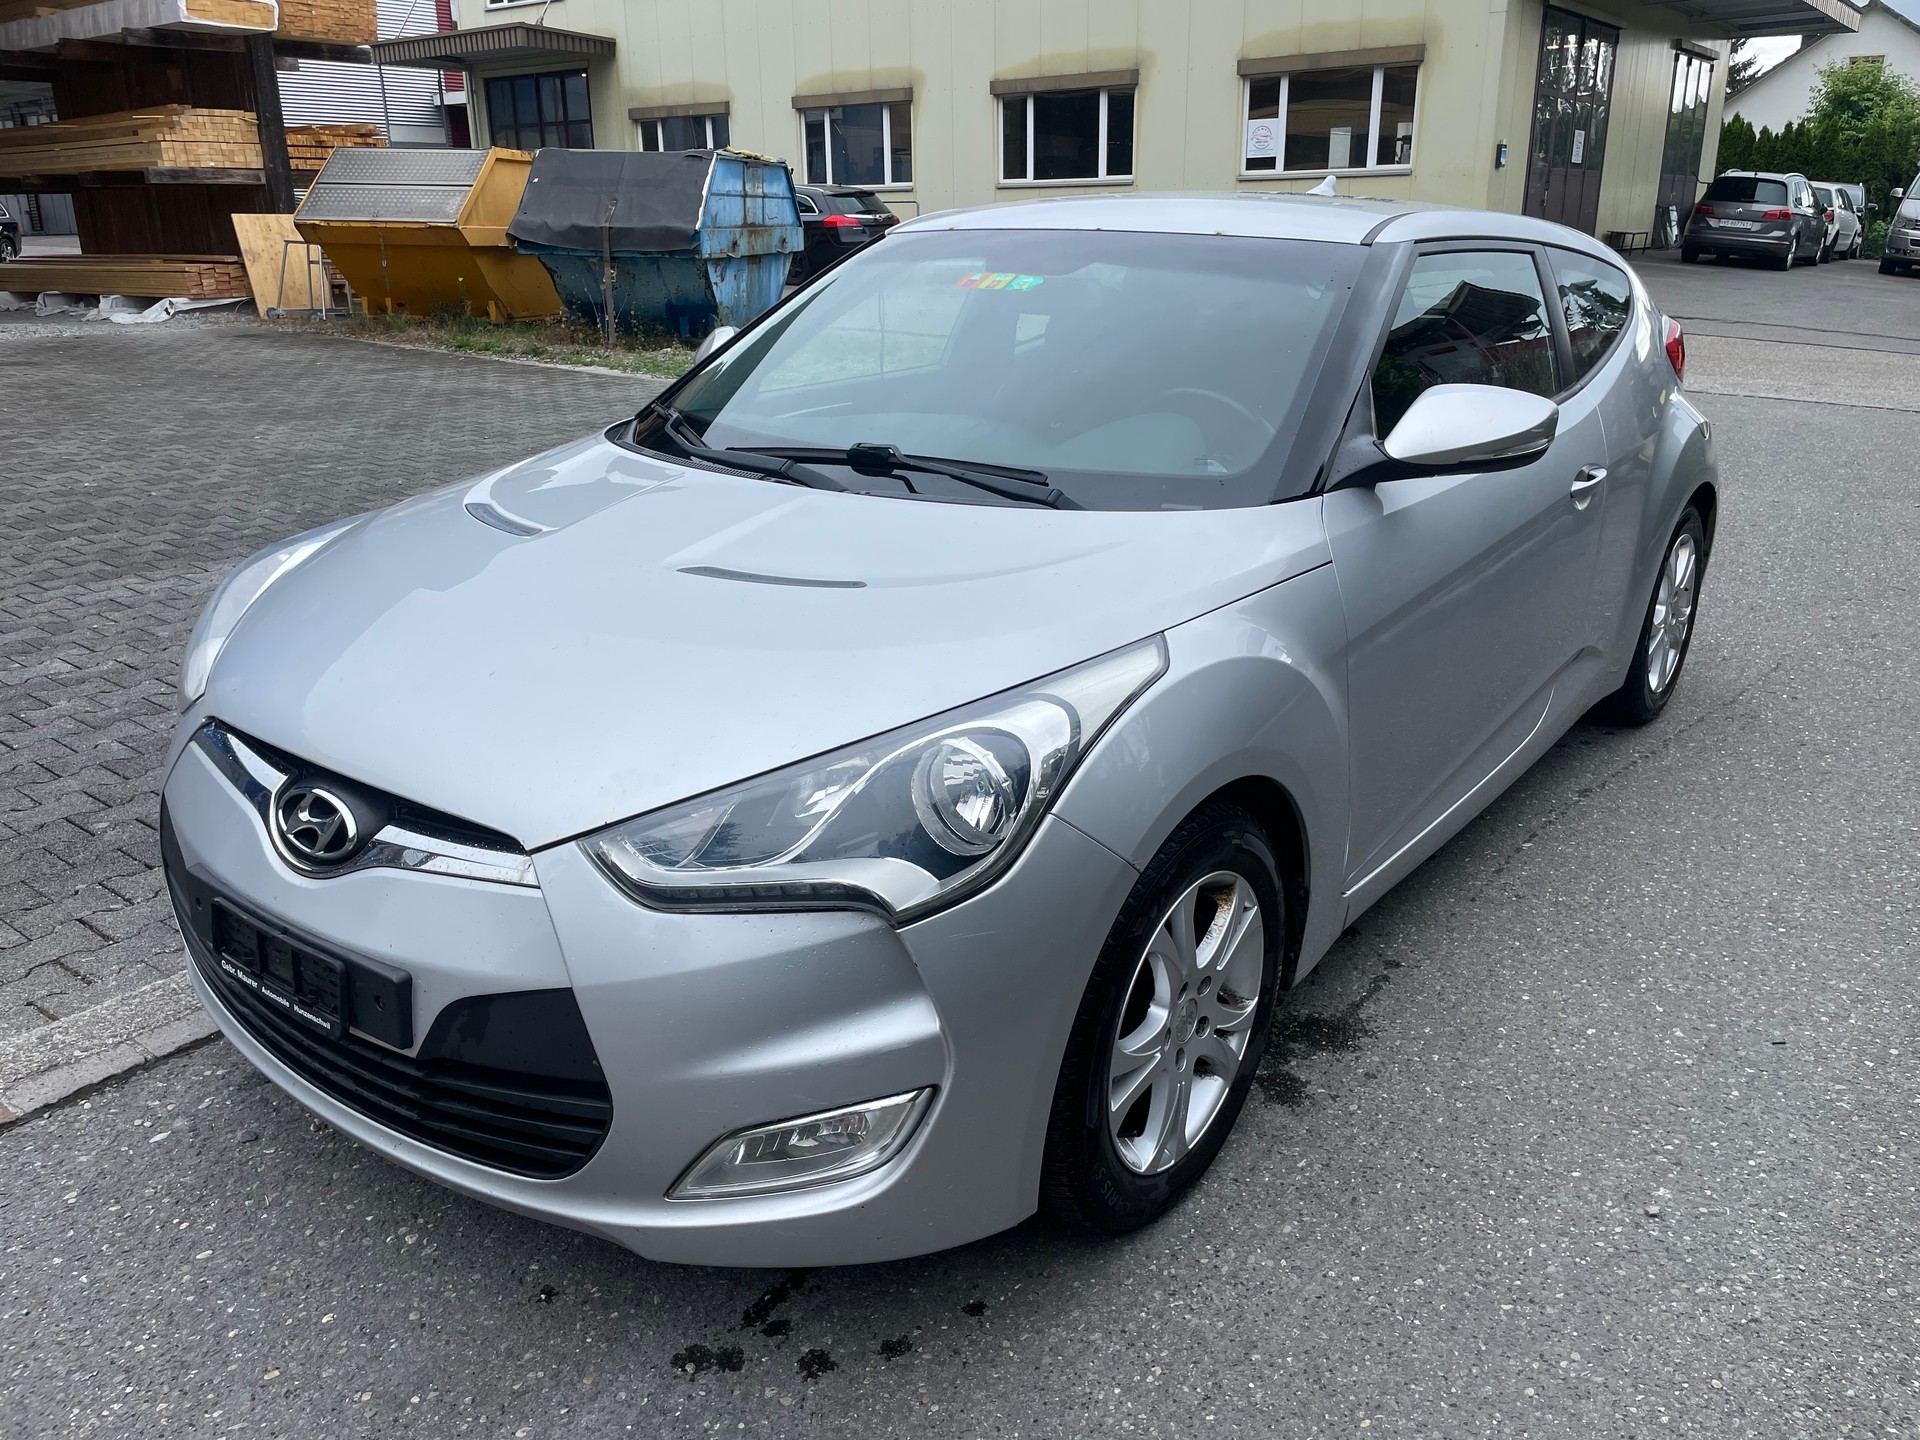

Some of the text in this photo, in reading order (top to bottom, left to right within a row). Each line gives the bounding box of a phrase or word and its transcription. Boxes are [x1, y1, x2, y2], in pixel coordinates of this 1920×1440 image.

[221, 960, 331, 1030] Gebr. Maurer Automobile Hunzenschwil
